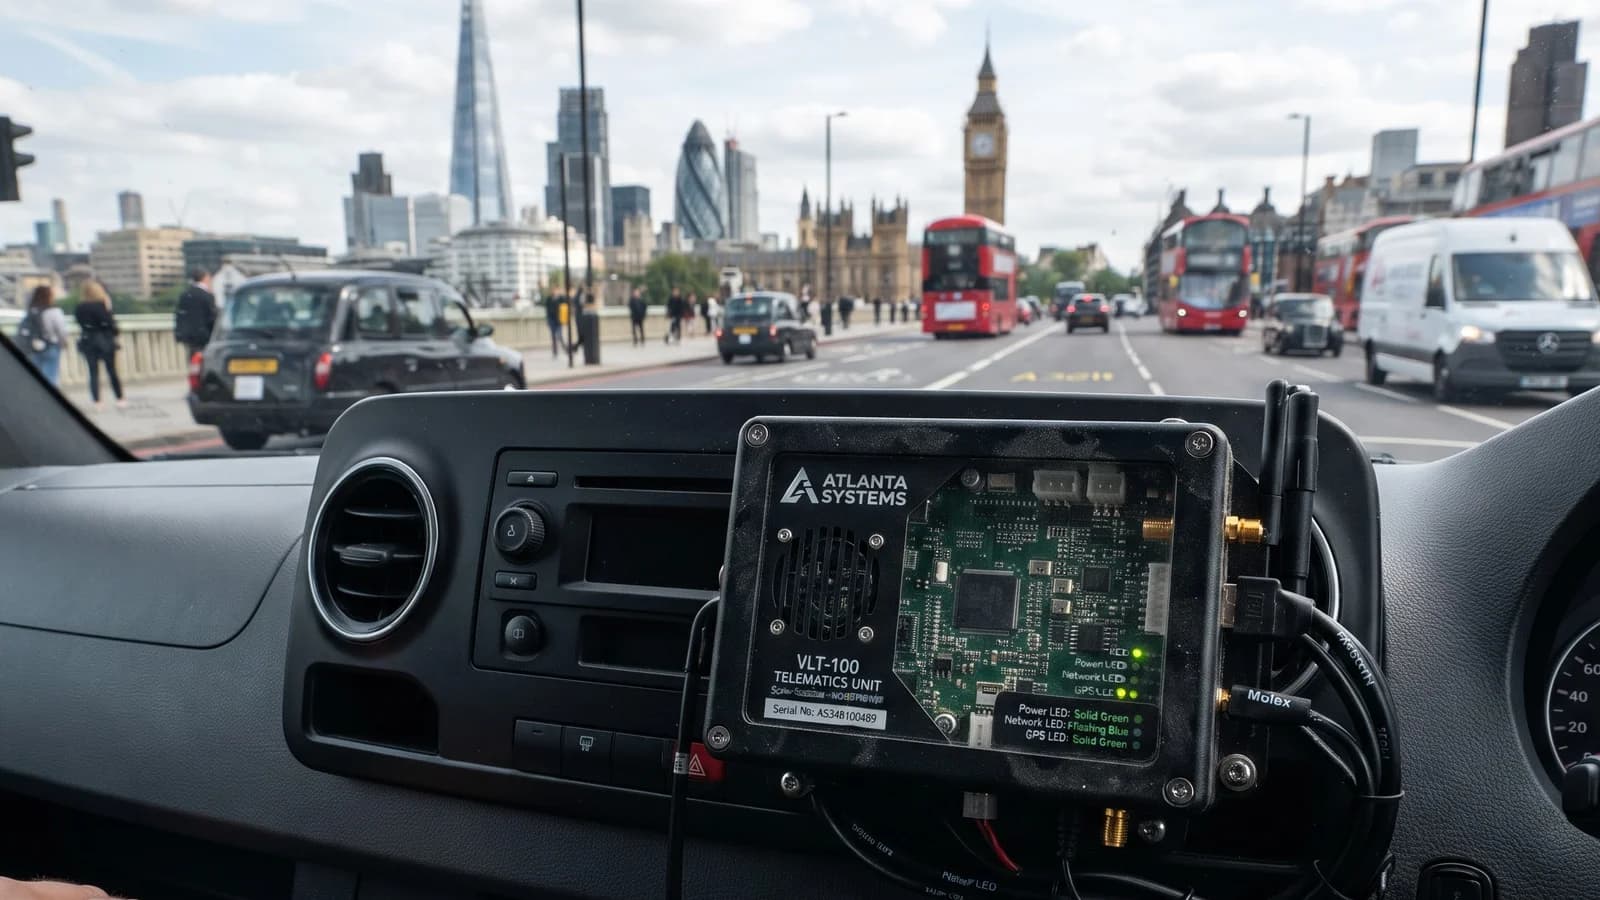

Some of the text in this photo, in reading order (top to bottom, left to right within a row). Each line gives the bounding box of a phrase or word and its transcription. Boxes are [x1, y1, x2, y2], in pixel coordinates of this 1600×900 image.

[823, 473, 908, 490] ATLANTA
[821, 489, 907, 506] SYSTEMS
[797, 653, 860, 675] VLT-100
[1584, 663, 1600, 675] 60
[774, 670, 883, 692] TELEMATICS UNIT
[1074, 686, 1095, 696] GPS
[1247, 689, 1292, 709] Molex
[1569, 690, 1588, 703] 40
[773, 704, 797, 715] Serial
[1018, 703, 1129, 724] Power LED: Solid Green
[1004, 715, 1043, 728] Network
[1045, 718, 1067, 729] LED:
[1108, 725, 1129, 737] Blue
[1568, 721, 1588, 734] 20
[1025, 729, 1128, 750] GPS LED: Solid Green
